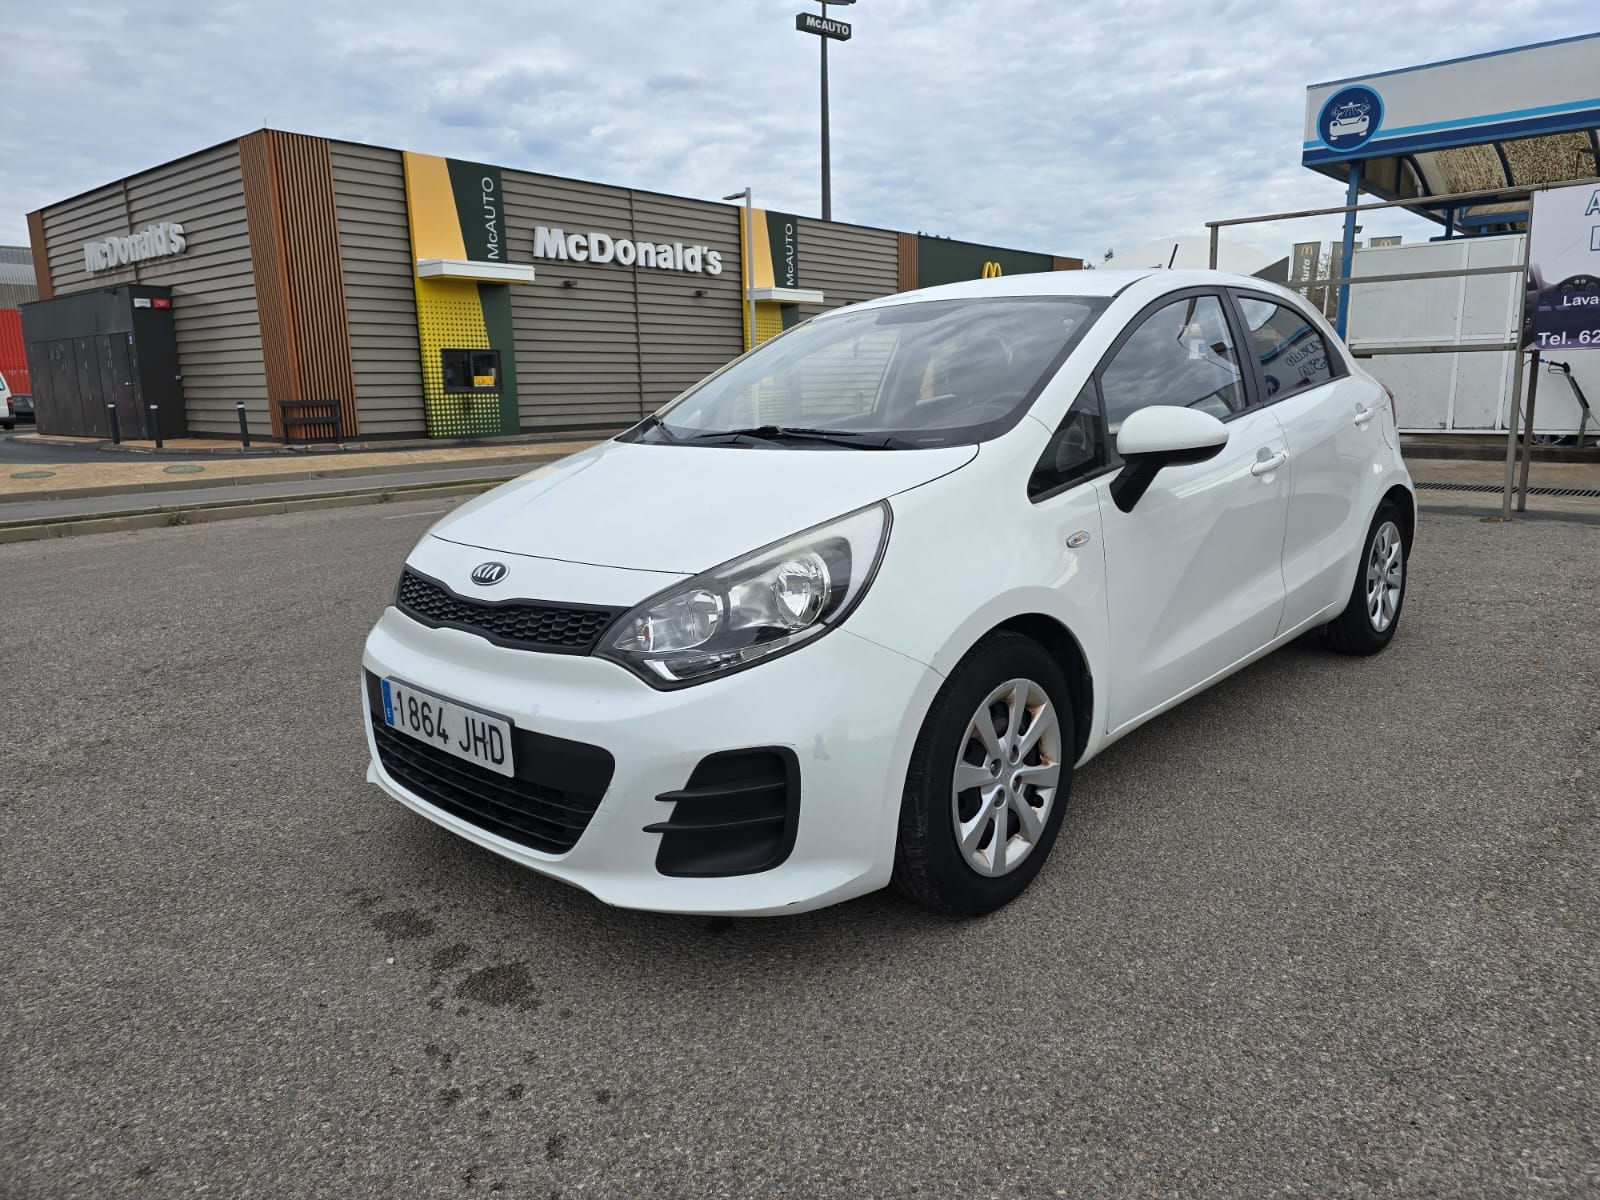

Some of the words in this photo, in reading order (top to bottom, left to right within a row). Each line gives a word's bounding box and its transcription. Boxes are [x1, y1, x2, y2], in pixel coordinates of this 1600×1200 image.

[806, 15, 849, 36] McAUTO
[481, 177, 500, 259] McAUTO
[84, 222, 186, 272] McDonald's
[533, 226, 722, 275] McDonald's
[785, 223, 794, 286] McAUTO
[1538, 331, 1572, 346] Tel.
[1579, 330, 1600, 344] 62
[473, 565, 501, 580] KIA
[397, 690, 449, 744] 1864
[459, 716, 505, 765] JHD
